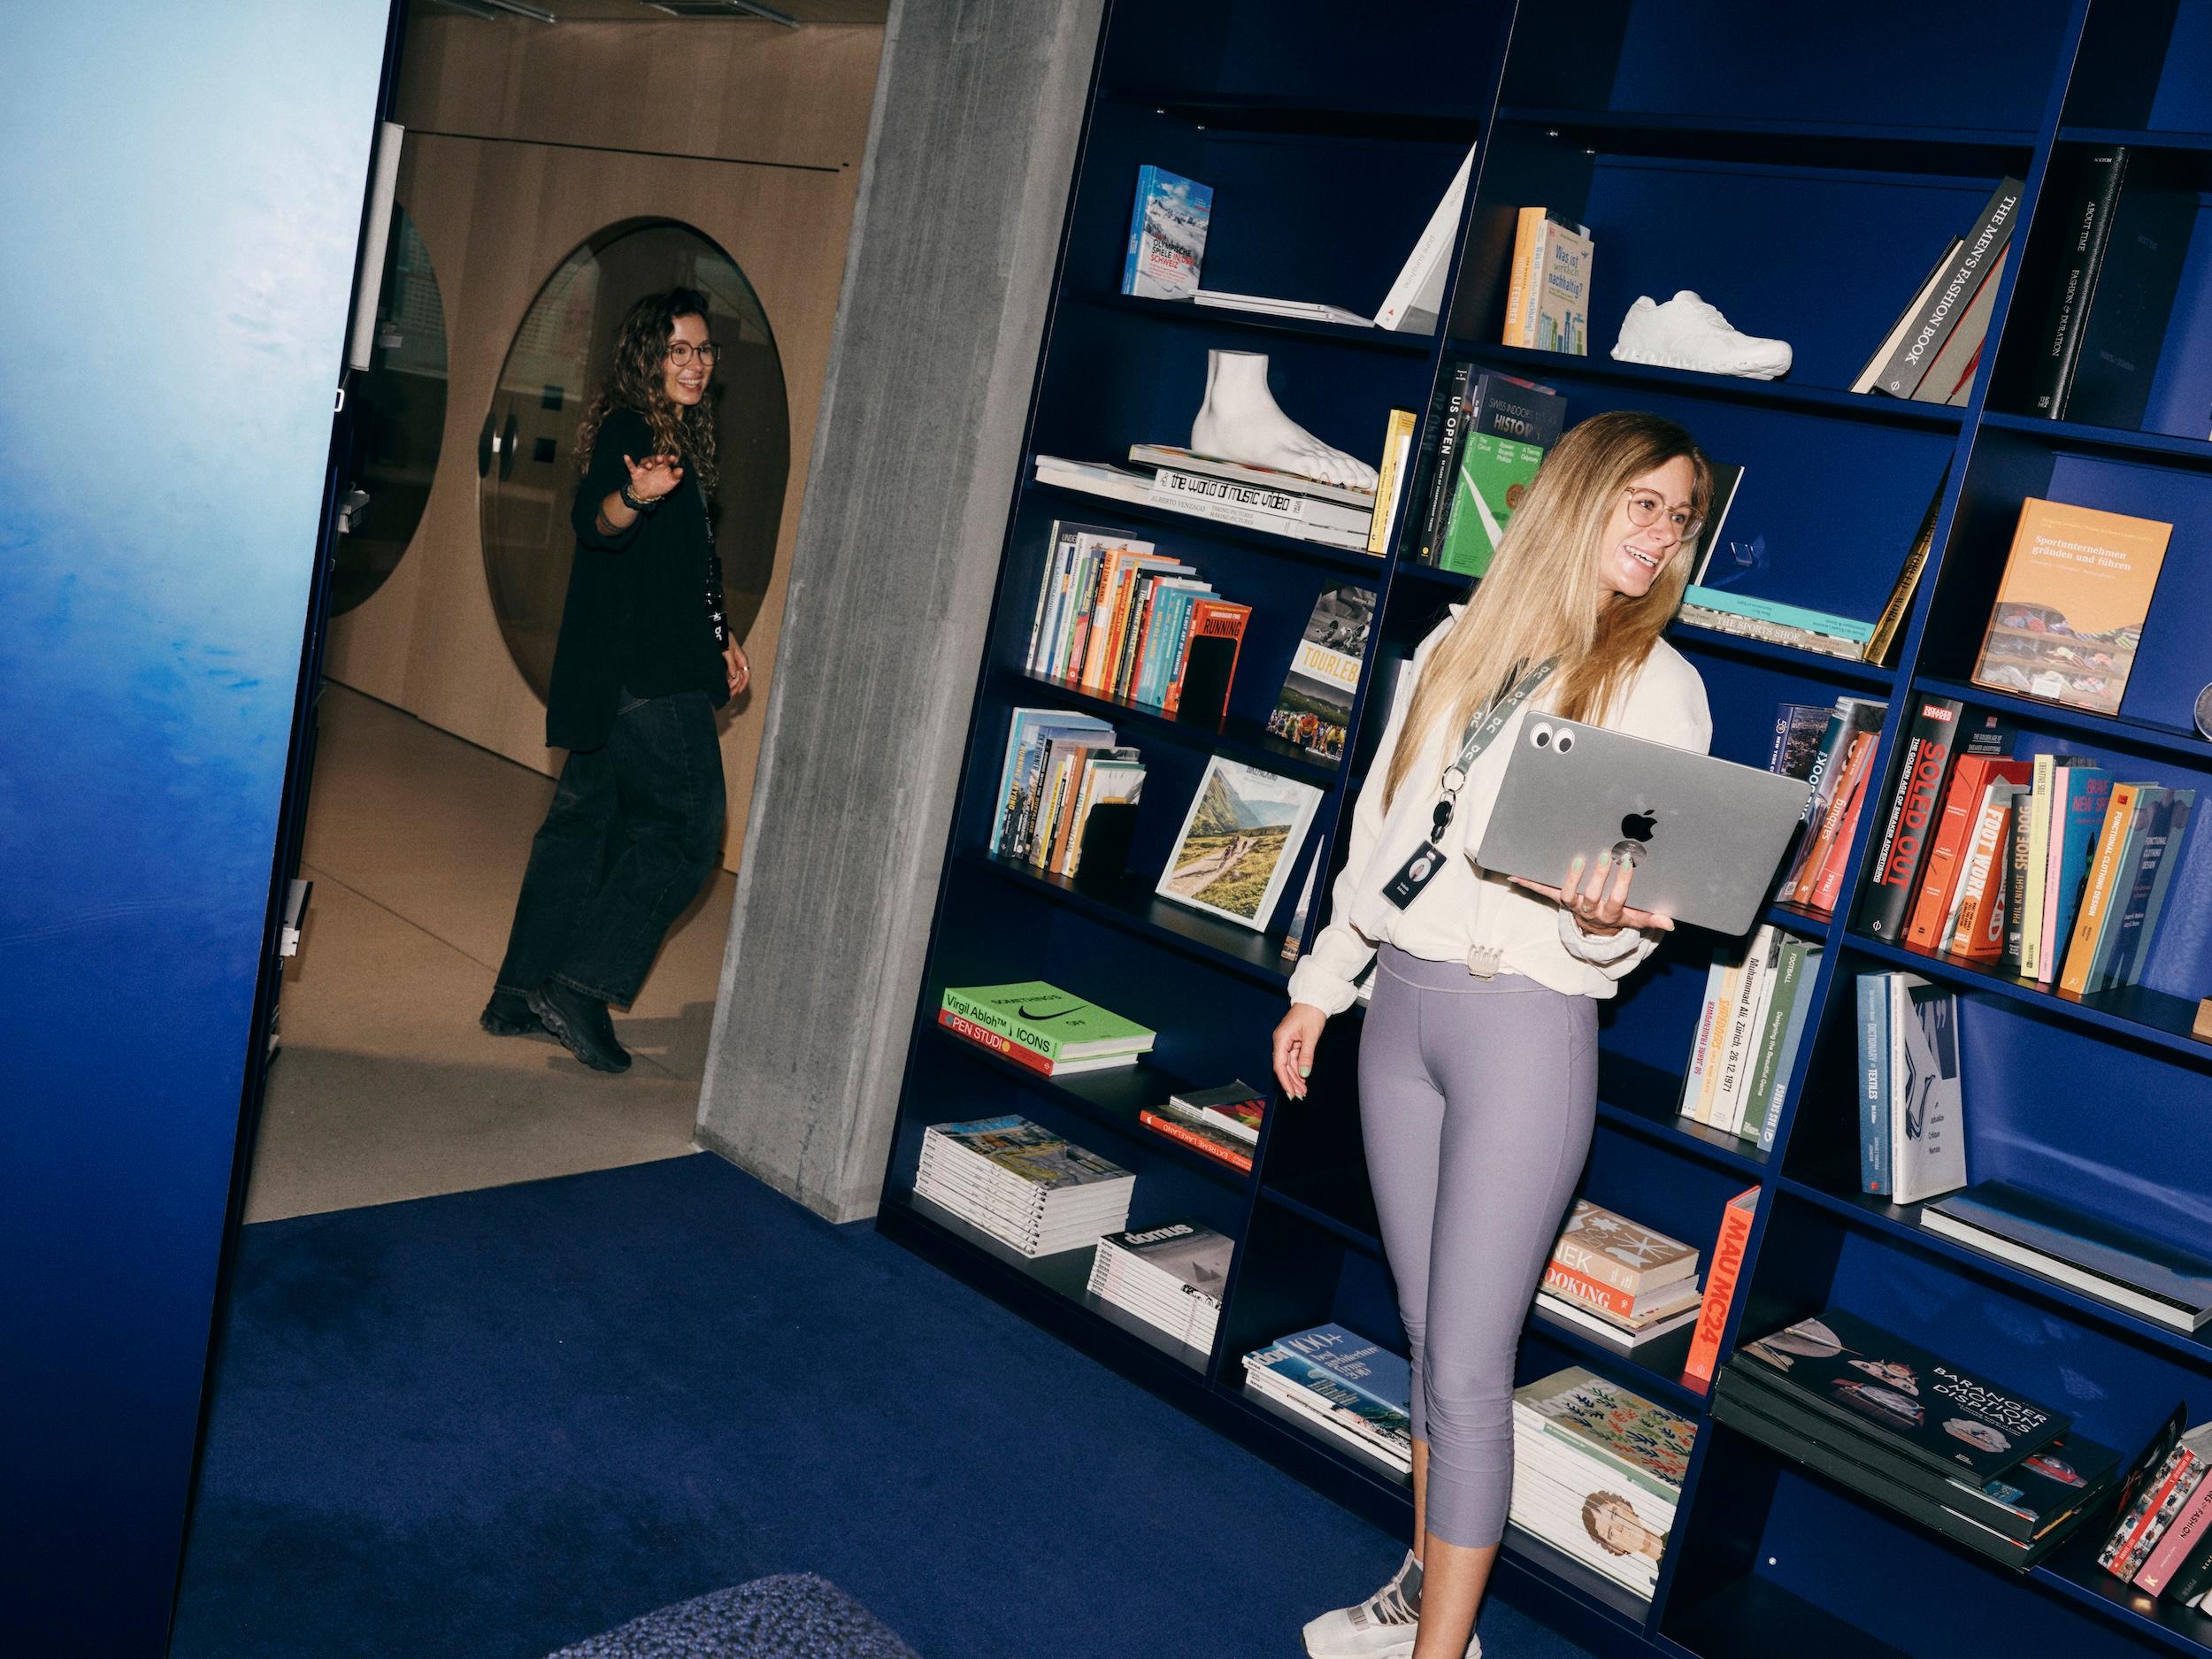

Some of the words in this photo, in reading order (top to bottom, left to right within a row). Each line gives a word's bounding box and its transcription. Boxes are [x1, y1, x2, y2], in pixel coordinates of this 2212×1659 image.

[1992, 196, 2017, 226] THE
[2082, 202, 2096, 232] ABOUT
[1151, 247, 1171, 258] SPIELE
[1555, 244, 1570, 264] Was
[1570, 251, 1579, 266] ist
[1965, 223, 1998, 268] MEN'S
[2078, 231, 2088, 252] TIME
[1150, 255, 1179, 268] SCHWEIZ
[1548, 273, 1583, 299] nachhaltig?
[1929, 267, 1972, 327] FASHION
[2064, 269, 2080, 304] FASHION
[1505, 284, 1523, 325] FEDERER
[1904, 326, 1936, 366] BOOK
[2052, 311, 2070, 357] DURATION
[1450, 396, 1461, 413] US
[1488, 397, 1507, 412] SWISS
[1441, 418, 1457, 455] OPEN
[1150, 495, 1175, 507] ALBERTO
[1177, 499, 1206, 513] VENZAGO
[1171, 473, 1186, 490] the
[1187, 478, 1217, 497] world
[1218, 482, 1229, 498] of
[1229, 486, 1261, 507] music
[1263, 489, 1290, 511] video
[1427, 485, 1441, 516] CHAMPIONSHIP
[2032, 545, 2073, 561] gründen
[2076, 553, 2094, 565] und
[2098, 556, 2131, 572] führen
[2036, 535, 2127, 560] Sportunternehmen
[1120, 580, 1130, 613] RUNNING
[1139, 589, 1148, 604] THE
[1203, 618, 1242, 637] RUNNING
[1715, 616, 1736, 628] THE
[1737, 619, 1773, 636] SPORTS
[1774, 627, 1801, 642] SHOE
[1171, 649, 1182, 675] RUNNING
[1304, 646, 1359, 682] TOURLEB
[1911, 737, 1920, 751] THE
[1013, 744, 1027, 779] RUNNING
[1032, 748, 1043, 772] RUNNER
[1903, 751, 1916, 780] GOLDEN
[1008, 780, 1019, 811] BEYOND
[1895, 795, 1904, 806] OF
[1899, 780, 1909, 795] AGE
[1905, 741, 1946, 829] SOLED
[1029, 799, 1039, 834] BUFFALOES
[1068, 792, 1083, 853] MURAKAMI
[1822, 798, 1847, 841] salzburg
[1886, 805, 1901, 838] SNEAKER
[1978, 806, 2004, 854] FOOT
[2018, 806, 2032, 833] DOG
[2104, 810, 2123, 856] FUNCTIONAL
[1873, 838, 1892, 883] ADVERTISING
[1888, 837, 1918, 893] OUT
[2015, 834, 2029, 871] SHOE
[1823, 873, 1836, 893] TRIAS
[1966, 849, 1993, 902] WORK
[2095, 854, 2111, 889] CLOTHING
[2015, 874, 2024, 903] KNIGHT
[2087, 888, 2101, 917] DESIGN
[1740, 957, 1759, 1004] Muhammad
[1784, 953, 1796, 984] FOOTBALL
[946, 994, 970, 1016] Virgil
[1017, 1027, 1051, 1053] ICONS
[1700, 1001, 1715, 1041] FRAUENPOWER
[1709, 997, 1731, 1050] SHREDDERS
[1736, 1005, 1748, 1020] Ali,
[1770, 1010, 1784, 1040] Designing
[1730, 1020, 1746, 1049] Zürich,
[1768, 1040, 1777, 1050] the
[1867, 1023, 1877, 1063] DICTIONARY
[1696, 1041, 1707, 1066] JAHRE
[1761, 1050, 1774, 1078] Beautiful
[1694, 1065, 1702, 1076] 50
[1721, 1049, 1740, 1093] 26.12.1971
[1868, 1068, 1878, 1100] TEXTILES
[1756, 1078, 1767, 1097] Game
[1770, 1083, 1786, 1114] SKIBUCH
[1766, 1112, 1778, 1127] DAS
[1163, 1124, 1198, 1147] LAKELAND
[1198, 1141, 1229, 1160] EXTREME
[1124, 1224, 1194, 1245] domus
[1718, 1216, 1747, 1282] MAU
[1700, 1275, 1732, 1346] MC24
[1288, 1333, 1344, 1354] 100+
[1325, 1346, 1381, 1367] architecture
[1933, 1367, 2047, 1423] BARANGER
[1933, 1385, 2032, 1432] DISPLAYS
[1948, 1384, 2039, 1427] MOTION
[2179, 1508, 2203, 1540] FASHION
